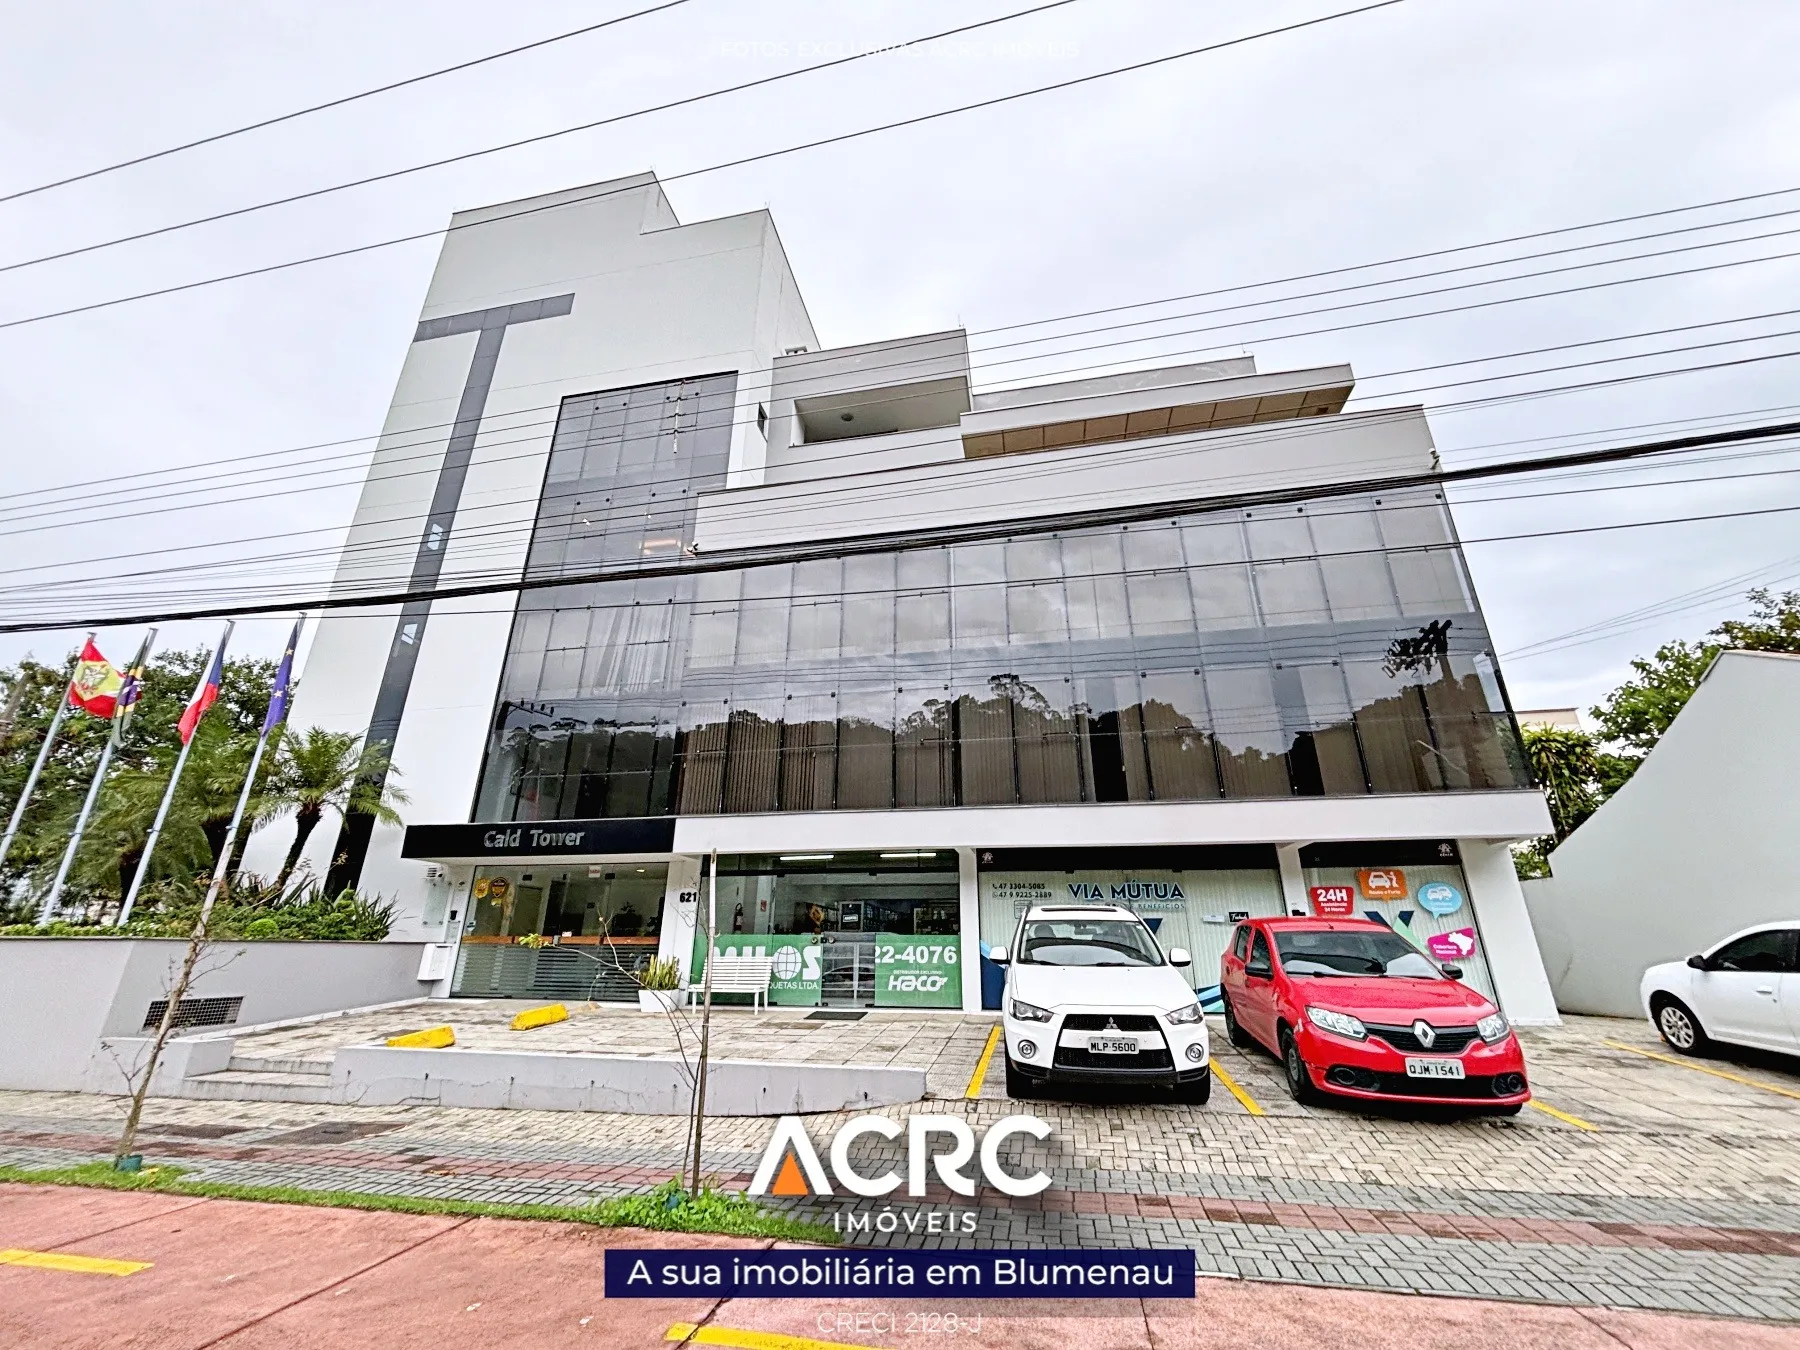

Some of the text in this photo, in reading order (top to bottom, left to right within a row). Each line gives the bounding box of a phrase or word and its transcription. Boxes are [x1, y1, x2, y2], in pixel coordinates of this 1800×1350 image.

[483, 829, 586, 848] Cald Tower
[680, 891, 697, 903] 621
[1067, 879, 1185, 899] VIA MÚTUA
[1317, 889, 1348, 902] 24H
